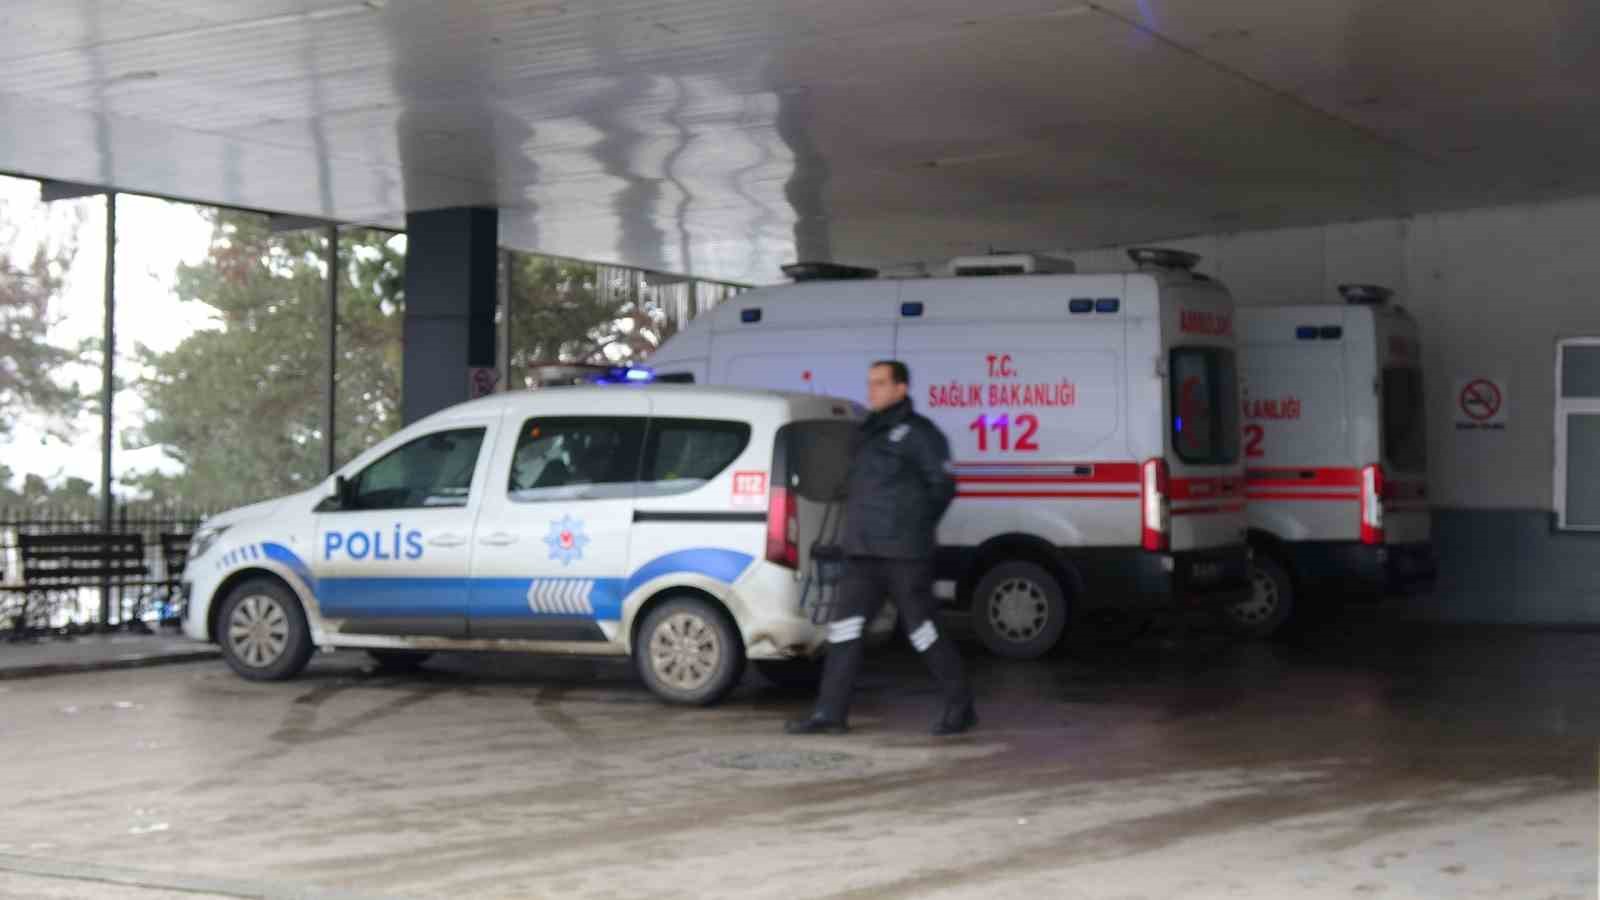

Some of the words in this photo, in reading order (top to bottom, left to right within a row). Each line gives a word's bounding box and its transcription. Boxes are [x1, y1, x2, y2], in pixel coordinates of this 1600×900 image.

[985, 354, 1018, 377] T.C.
[928, 378, 982, 408] SAĞLIK
[988, 376, 1076, 407] BAKANLIĞI
[968, 413, 1040, 452] 112
[734, 475, 764, 495] 112
[324, 522, 424, 561] POLİS
